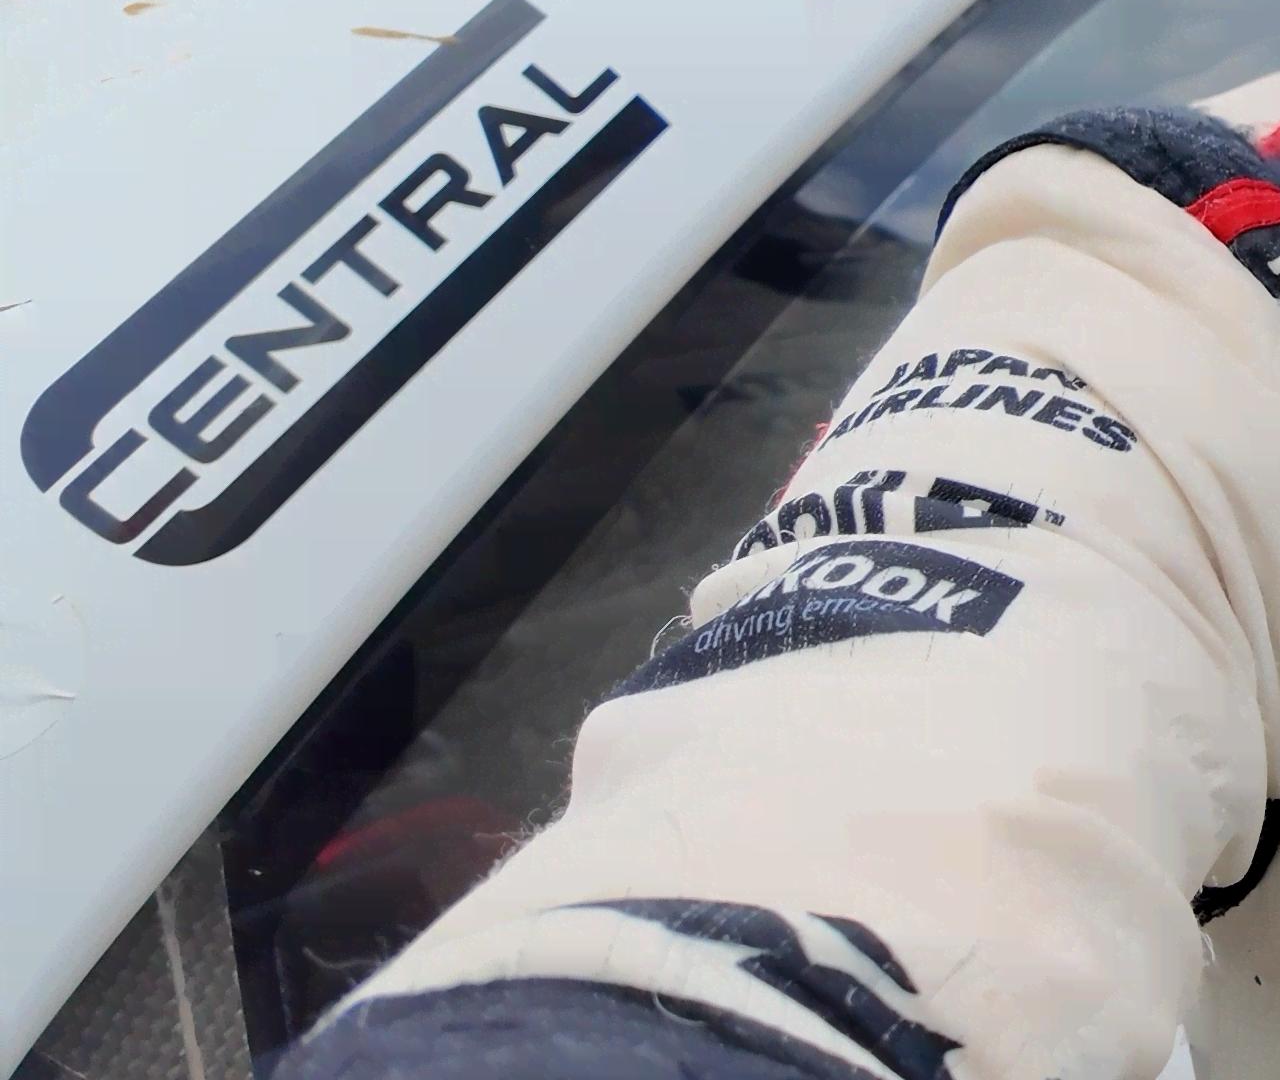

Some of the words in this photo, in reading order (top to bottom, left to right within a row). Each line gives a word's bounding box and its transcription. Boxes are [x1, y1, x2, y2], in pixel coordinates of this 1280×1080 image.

[59, 62, 620, 544] CENTRAL
[872, 347, 1087, 397] JAPAN
[817, 383, 1138, 453] AIRLINES
